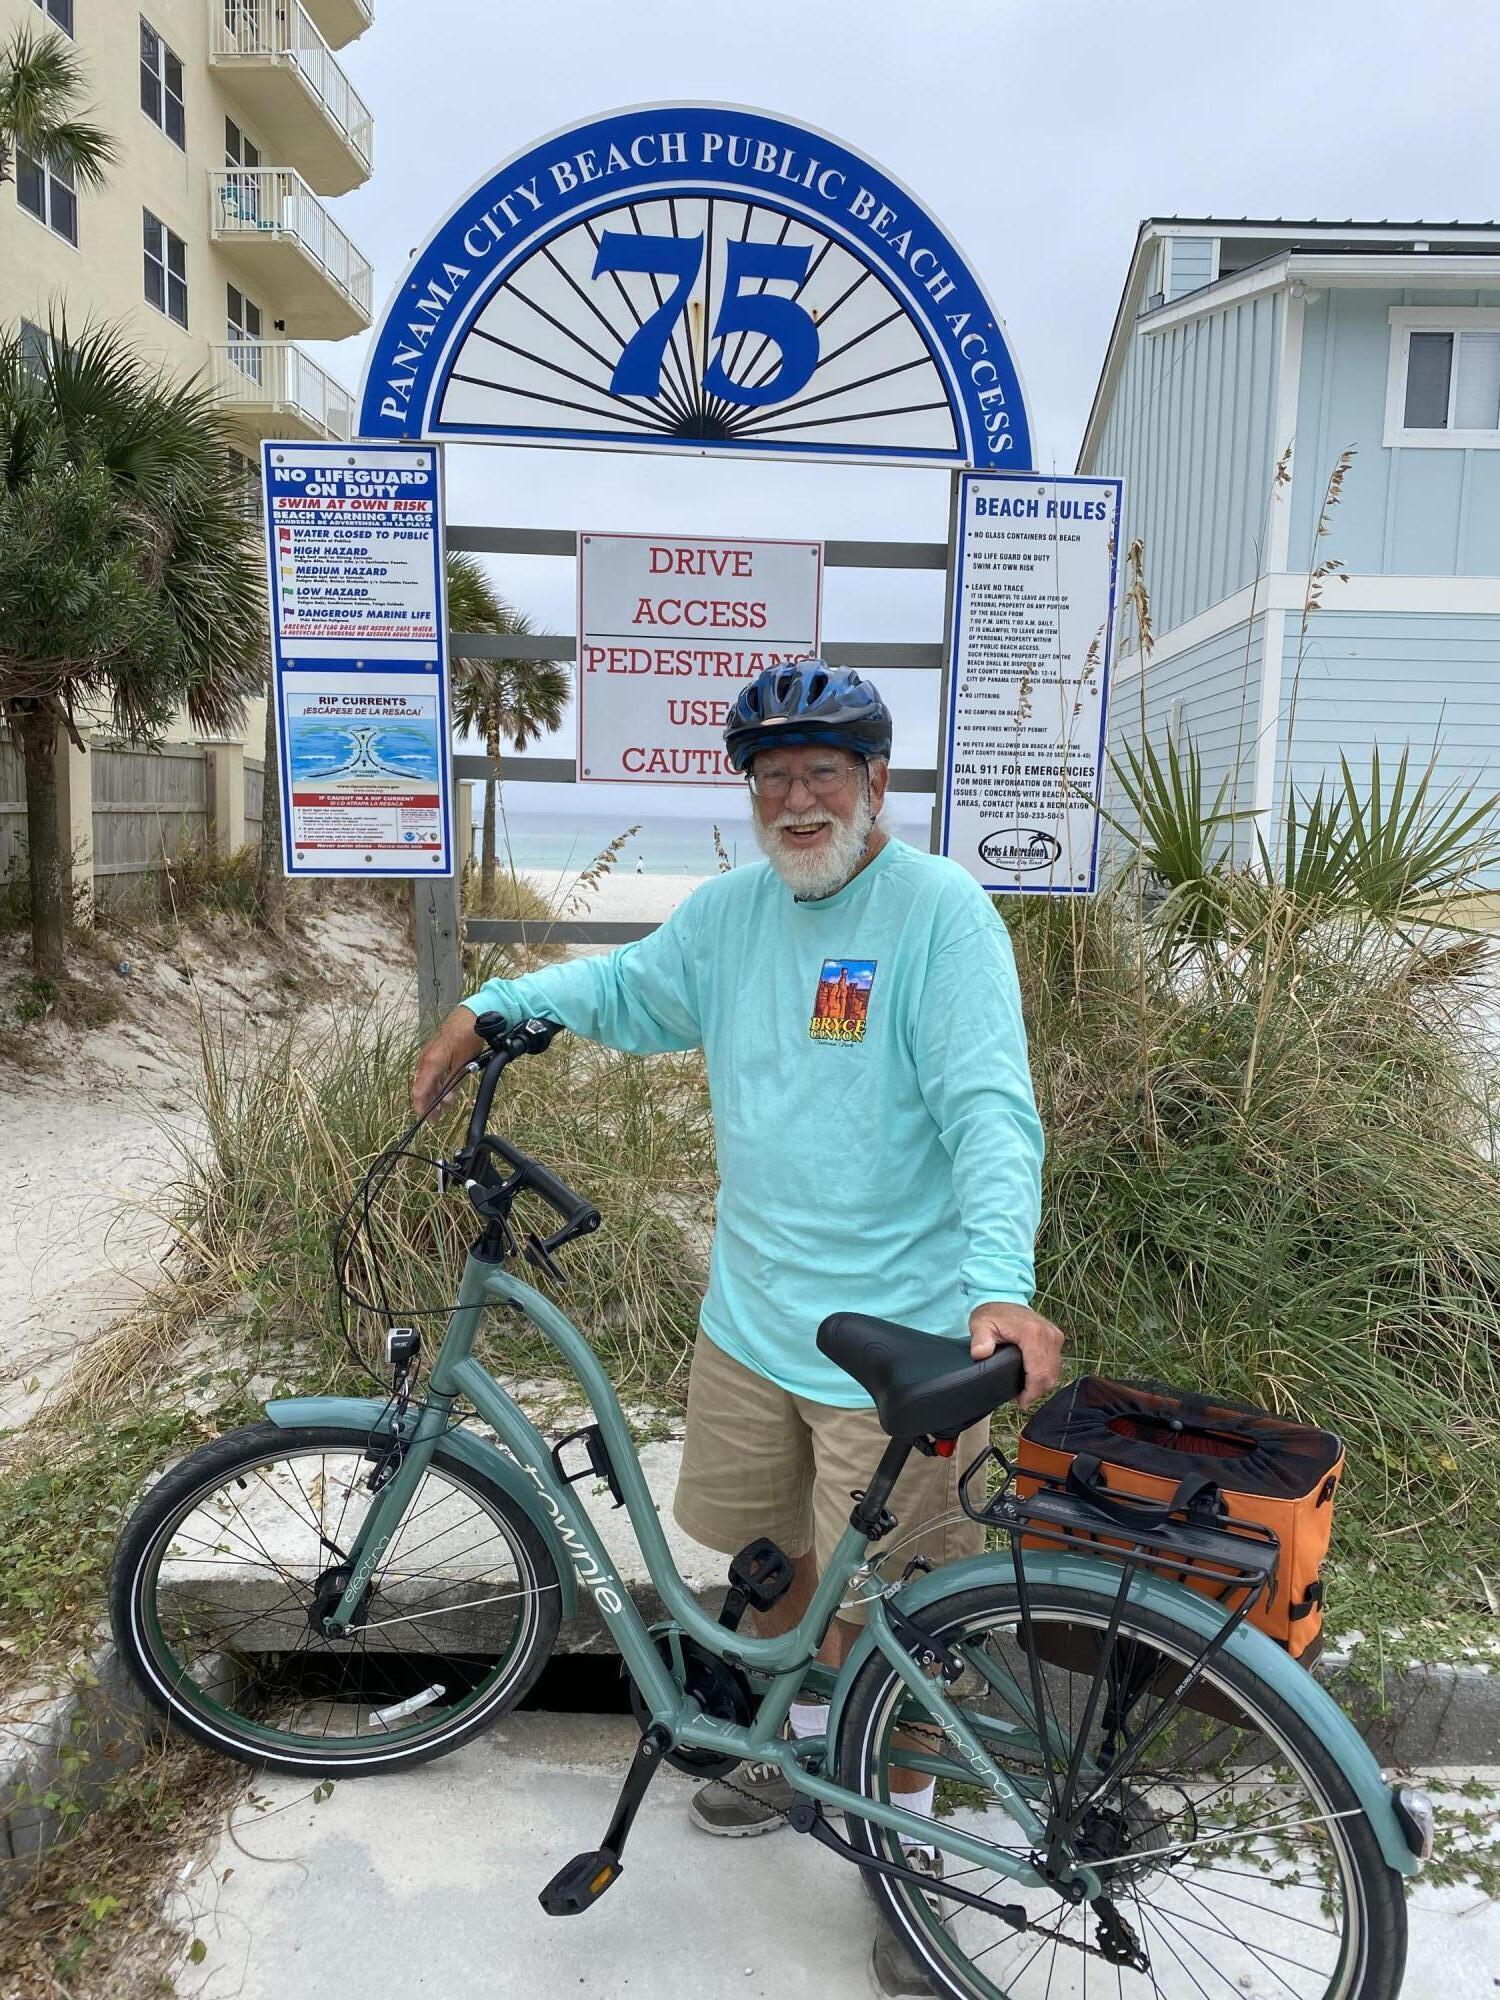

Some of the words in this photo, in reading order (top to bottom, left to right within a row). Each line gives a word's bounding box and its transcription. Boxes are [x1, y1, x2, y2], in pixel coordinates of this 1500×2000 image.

[379, 264, 469, 422] PANAMA
[463, 177, 544, 257] CITY
[549, 132, 687, 194] BEACH
[701, 132, 848, 201] PUBLIC
[847, 186, 959, 302] BEACH
[945, 311, 1013, 454] ACCESS
[591, 229, 820, 406] 75
[274, 469, 306, 482] NO
[314, 469, 428, 484] LIFEGUARD
[305, 483, 336, 496] ON
[345, 484, 399, 497] DUTY
[278, 498, 320, 509] SWIM
[326, 499, 345, 509] AT
[350, 499, 388, 510] OWN
[393, 500, 427, 510] RISK
[975, 497, 1038, 518] BEACH
[1046, 500, 1106, 520] RULES
[273, 511, 314, 519] BEACH
[320, 512, 386, 520] WARNING
[391, 513, 432, 521] FLAGS
[293, 529, 329, 538] WATER
[333, 530, 372, 538] CLOSED
[376, 530, 388, 538] TO
[392, 531, 428, 539] PUBLIC
[293, 546, 322, 554] HIGH
[323, 547, 367, 555] HAZARD
[649, 547, 752, 577] DRIVE
[296, 566, 339, 574] MEDIUM
[343, 567, 387, 575] HAZARD
[296, 587, 321, 595] LOW
[324, 588, 368, 596] HAZARD
[297, 609, 362, 618] DANGEROUS
[366, 610, 407, 618] MARINE
[632, 598, 766, 628] ACCESS
[586, 647, 809, 678] PEDESTRIA
[342, 697, 406, 705] CURRENTS
[354, 706, 366, 715] DE
[368, 706, 380, 715] LA
[382, 706, 421, 716] RESACA!
[668, 700, 730, 726] USE
[622, 747, 746, 776] CAUTIO
[955, 763, 976, 773] DIAL
[980, 764, 997, 774] 911
[1001, 765, 1021, 774] FOR
[1024, 766, 1094, 776] EMERGENCIES
[993, 778, 1039, 786] INFORMATION
[953, 788, 976, 796] ISSUES
[984, 789, 1020, 797] CONCERNS
[956, 799, 980, 807] AREAS,
[982, 800, 1013, 808] CONTACT
[979, 810, 1003, 818] OFFICE
[983, 845, 1001, 856] Parks
[1002, 845, 1007, 856] &
[810, 1017, 866, 1032] BRYCE
[344, 1535, 389, 1603] electra
[930, 1712, 1014, 1799] electra
